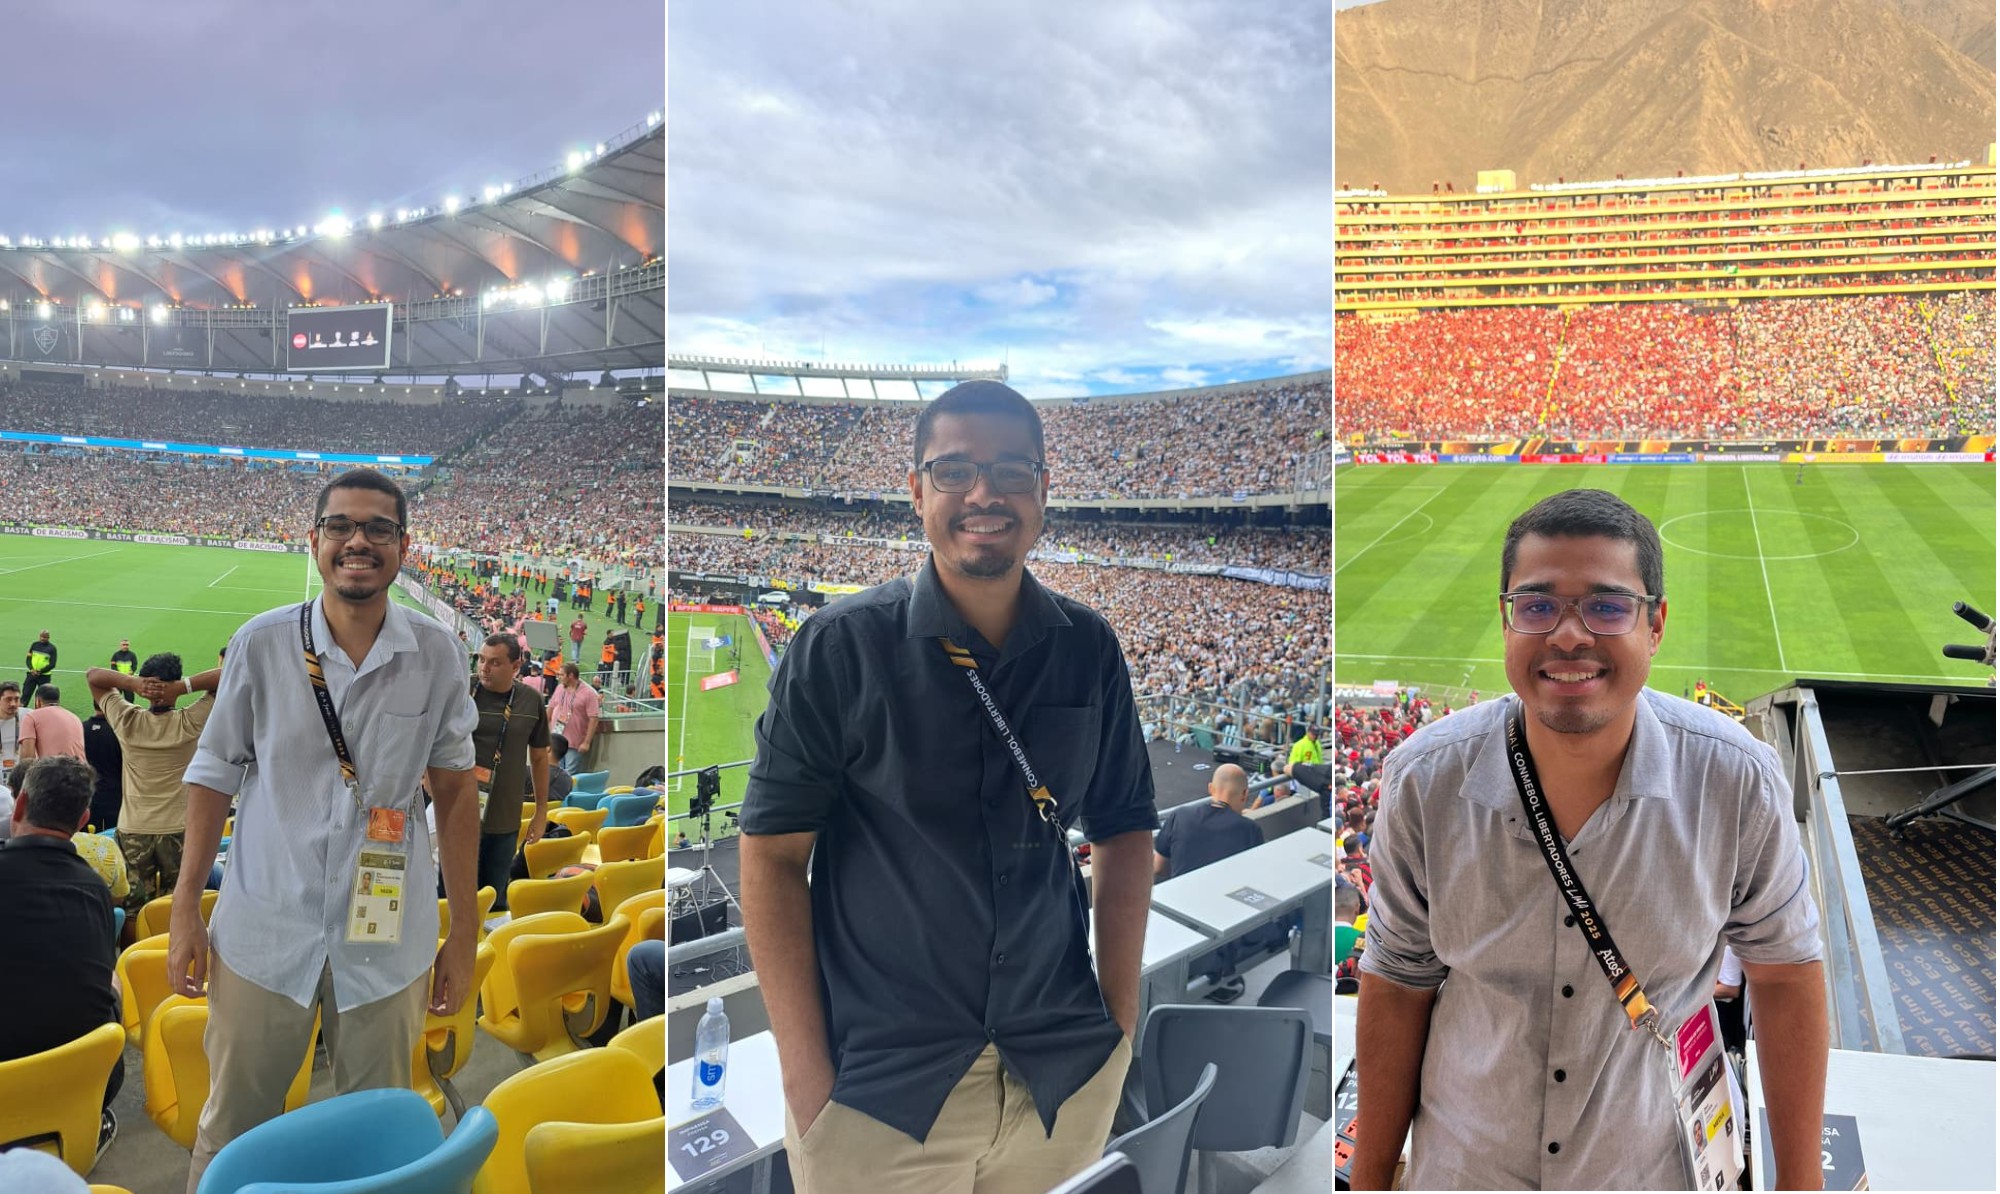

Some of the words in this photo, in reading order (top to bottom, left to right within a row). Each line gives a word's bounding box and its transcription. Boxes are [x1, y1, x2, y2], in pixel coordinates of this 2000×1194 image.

[1359, 455, 1379, 463] TCL
[1386, 455, 1407, 463] TCL
[1413, 455, 1434, 463] TCL
[1460, 455, 1506, 463] crypto.com
[4, 526, 30, 535] BASTA
[49, 529, 85, 537] RACISMO
[107, 533, 131, 541] BASTA
[150, 536, 185, 544] RACISMO
[208, 539, 231, 548] BASTA
[250, 543, 284, 551] RACISMO
[966, 669, 1010, 736] LIBERTADORES
[1007, 735, 1038, 788] CONMEBOL
[1508, 718, 1519, 751] FINAL
[1514, 752, 1539, 811] CONMEBOL
[1535, 812, 1573, 887] LIBERTADORES
[1581, 911, 1601, 939] 2025
[1871, 855, 1895, 874] Eco
[1888, 851, 1912, 869] Eco
[1905, 846, 1928, 864] Eco
[1961, 856, 1991, 877] Film
[1911, 869, 1939, 891] Film
[1928, 865, 1957, 887] Film
[1946, 861, 1974, 882] Film
[1875, 879, 1904, 902] Film
[1894, 874, 1923, 897] Film
[1902, 902, 1947, 940] Triplay
[1920, 897, 1966, 935] Triplay
[1938, 892, 1984, 929] Triplay
[1885, 907, 1929, 945] Triplay
[1952, 943, 1980, 967] Eco
[1970, 937, 1996, 960] Eco
[1599, 948, 1624, 978] Atos
[1913, 955, 1942, 980] Eco
[1932, 949, 1962, 973] Eco
[1893, 961, 1922, 986] Eco
[1941, 981, 1976, 1011] Film
[1961, 974, 1995, 1003] Film
[1901, 994, 1934, 1024] Film
[1921, 988, 1955, 1018] Film
[1337, 1092, 1358, 1110] 12
[681, 1129, 730, 1158] 129
